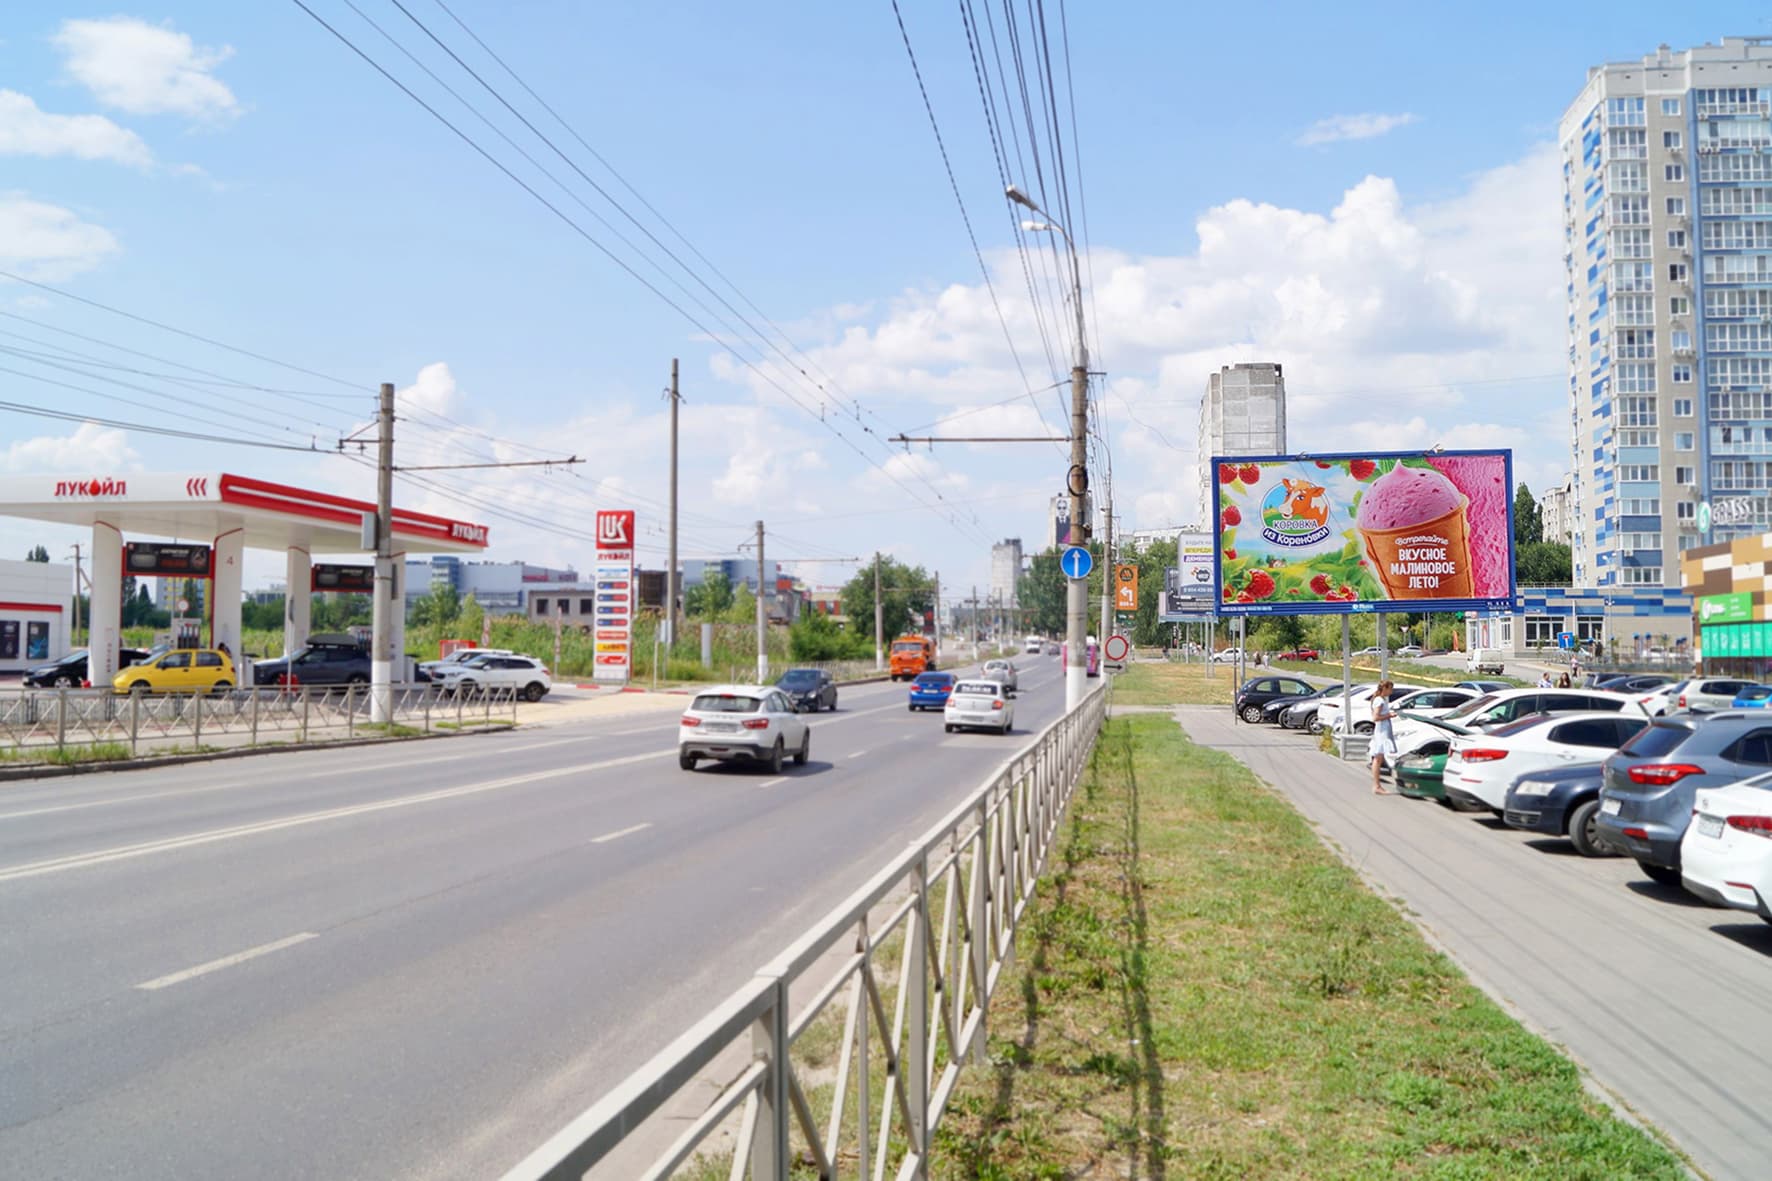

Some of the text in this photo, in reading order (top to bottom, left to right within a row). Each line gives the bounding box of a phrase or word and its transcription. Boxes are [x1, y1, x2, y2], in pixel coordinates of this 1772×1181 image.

[1712, 496, 1750, 526] GRASS
[1274, 520, 1318, 529] КОРОВКА
[1398, 548, 1447, 560] ВКУСНОЕ
[1390, 562, 1456, 575] МАЛИНОВОЕ
[1409, 576, 1439, 588] ЛЕТО!
